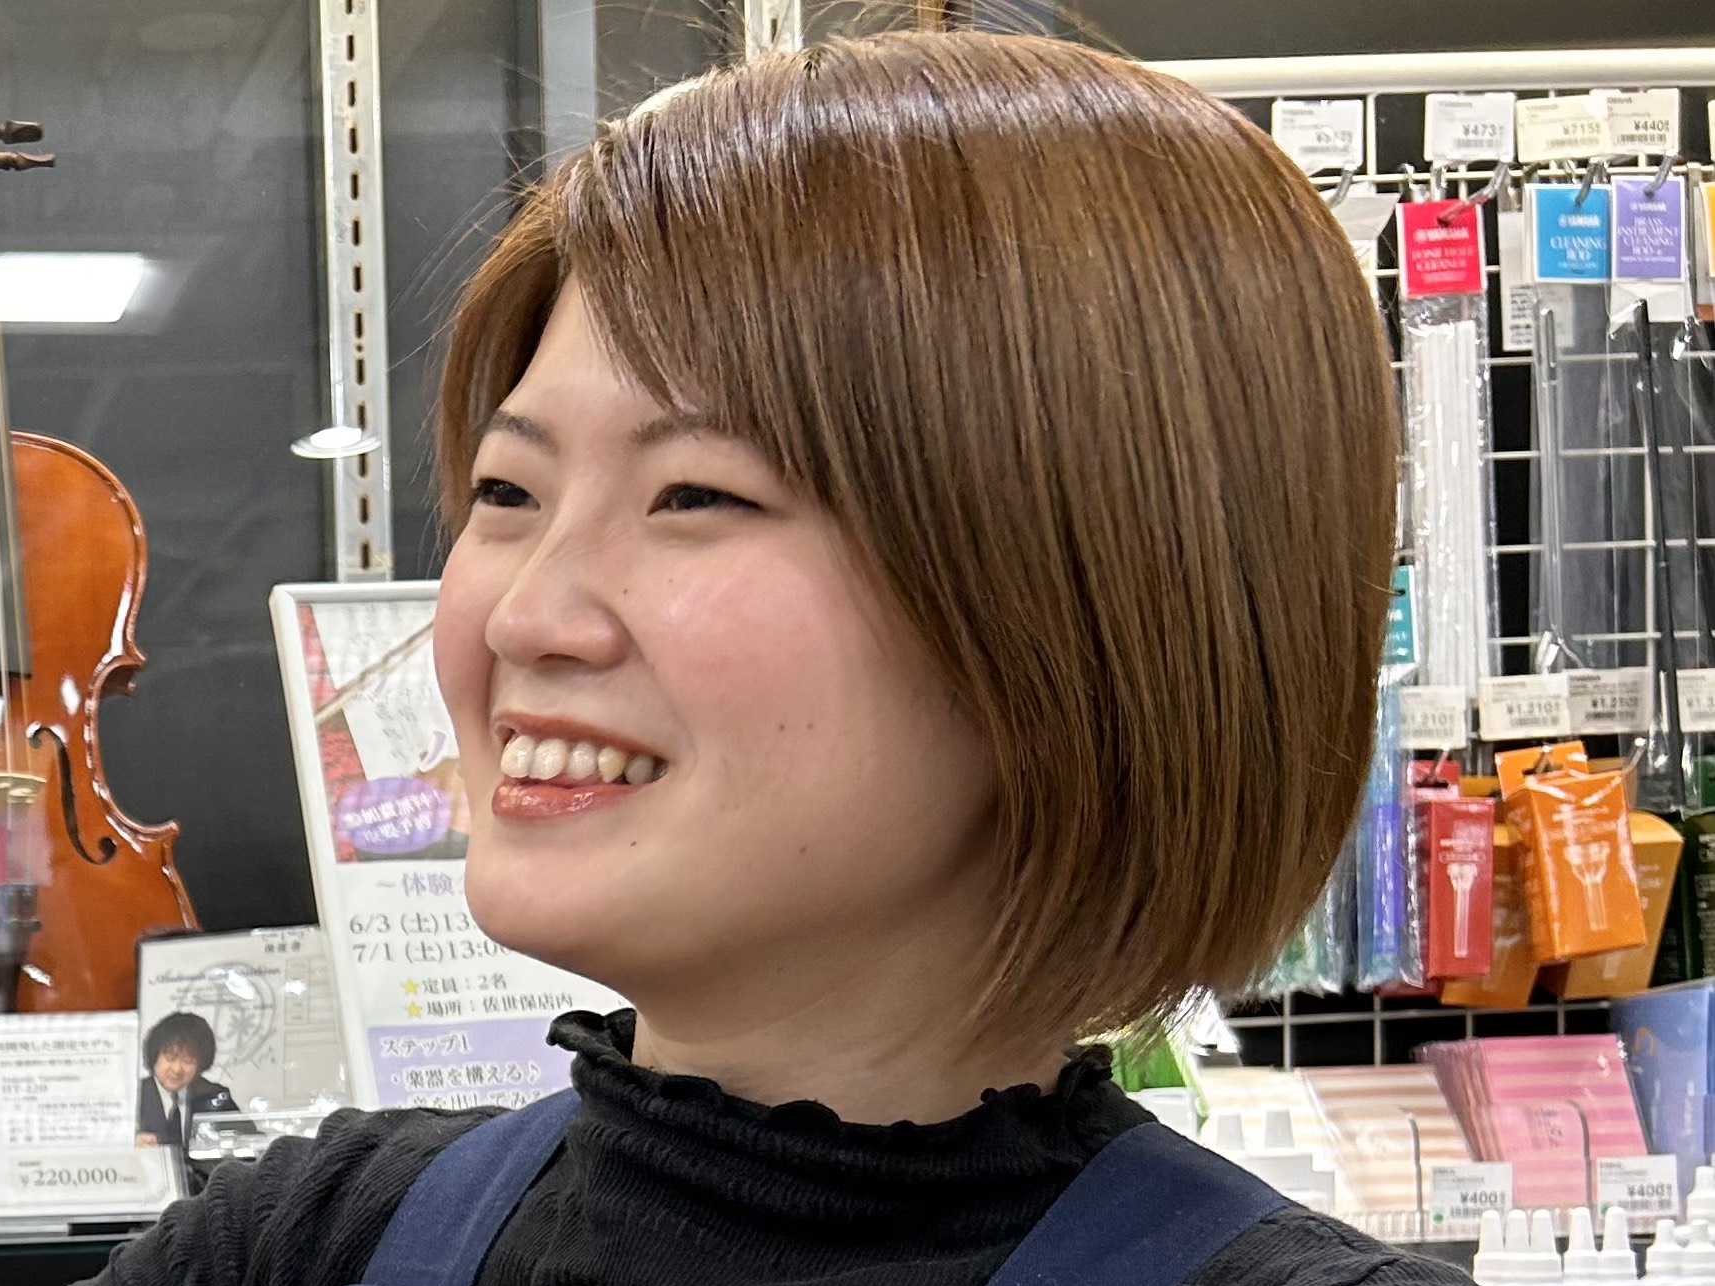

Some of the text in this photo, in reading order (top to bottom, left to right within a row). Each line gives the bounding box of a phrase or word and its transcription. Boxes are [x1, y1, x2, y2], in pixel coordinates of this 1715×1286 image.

[1549, 235, 1607, 251] CLEANING
[349, 912, 391, 935] 6/3
[352, 942, 395, 964] 7/1
[426, 992, 574, 1016] 場所：佐世保店内
[382, 1033, 470, 1055] ステップ1
[17, 1167, 119, 1187] ¥220,000
